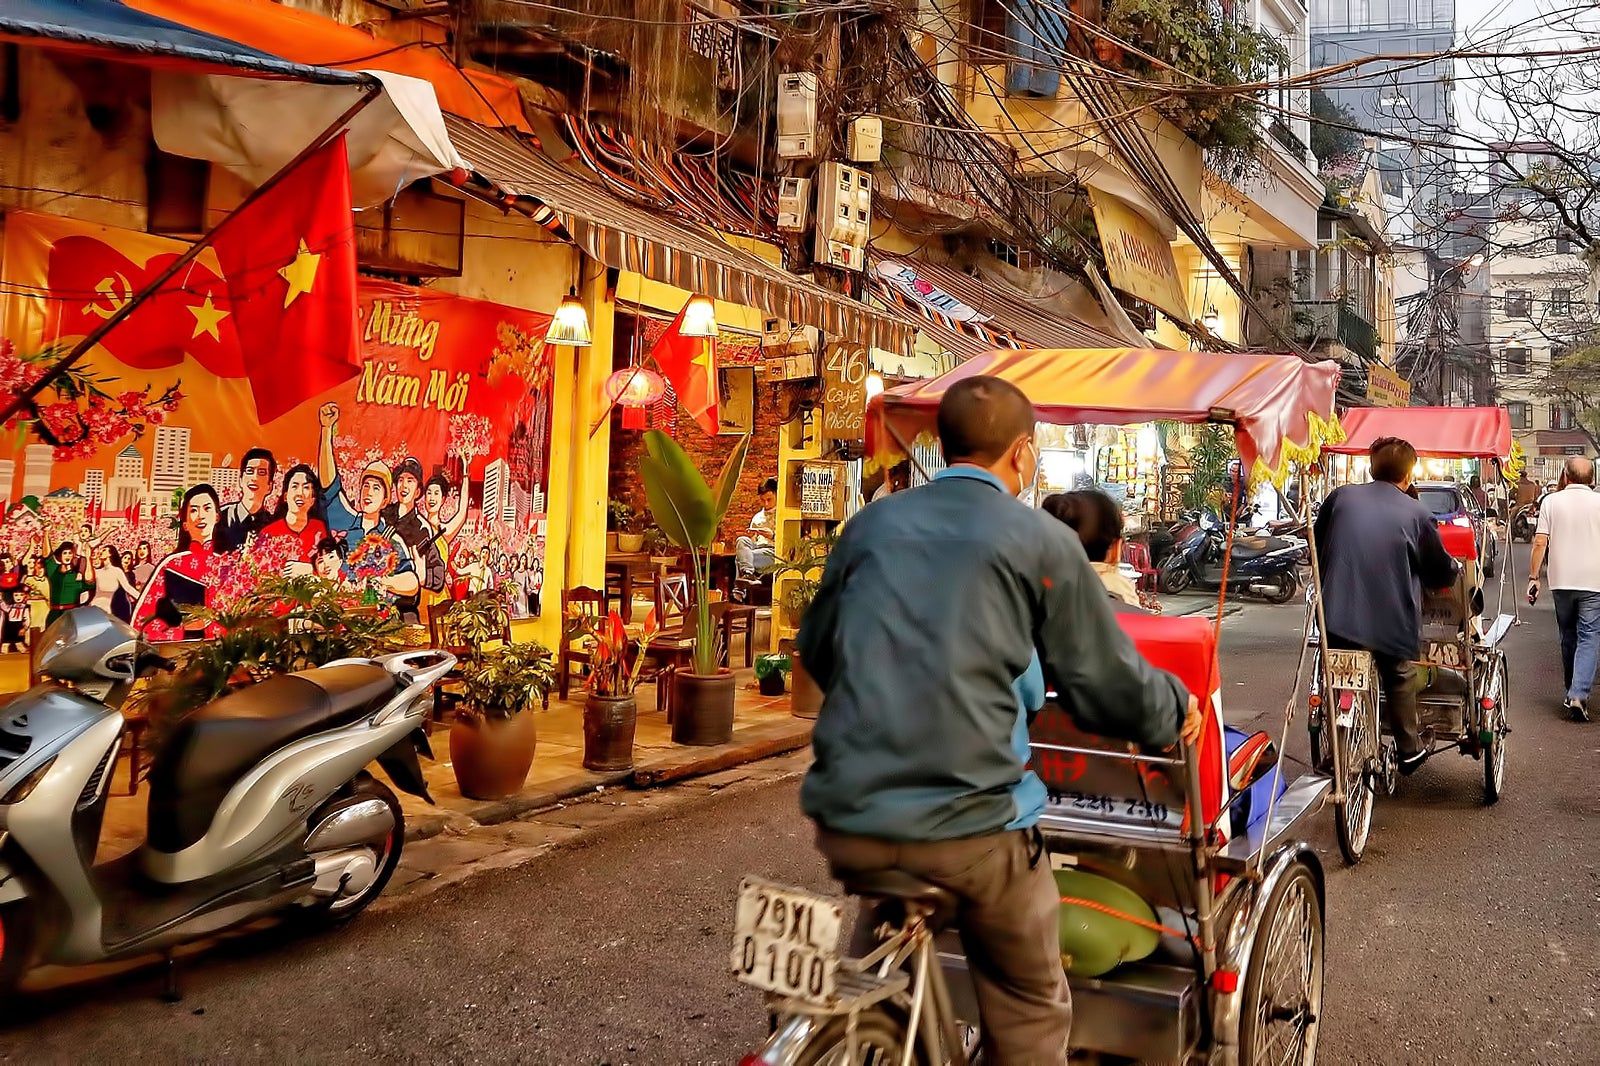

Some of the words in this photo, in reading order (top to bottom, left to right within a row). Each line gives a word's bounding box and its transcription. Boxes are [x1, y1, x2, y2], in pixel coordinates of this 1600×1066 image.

[364, 300, 440, 360] Mừng
[356, 360, 420, 406] Năm
[423, 369, 470, 412] Mới
[827, 346, 866, 384] 46
[754, 893, 819, 949] 29XL
[742, 935, 825, 996] 0100
